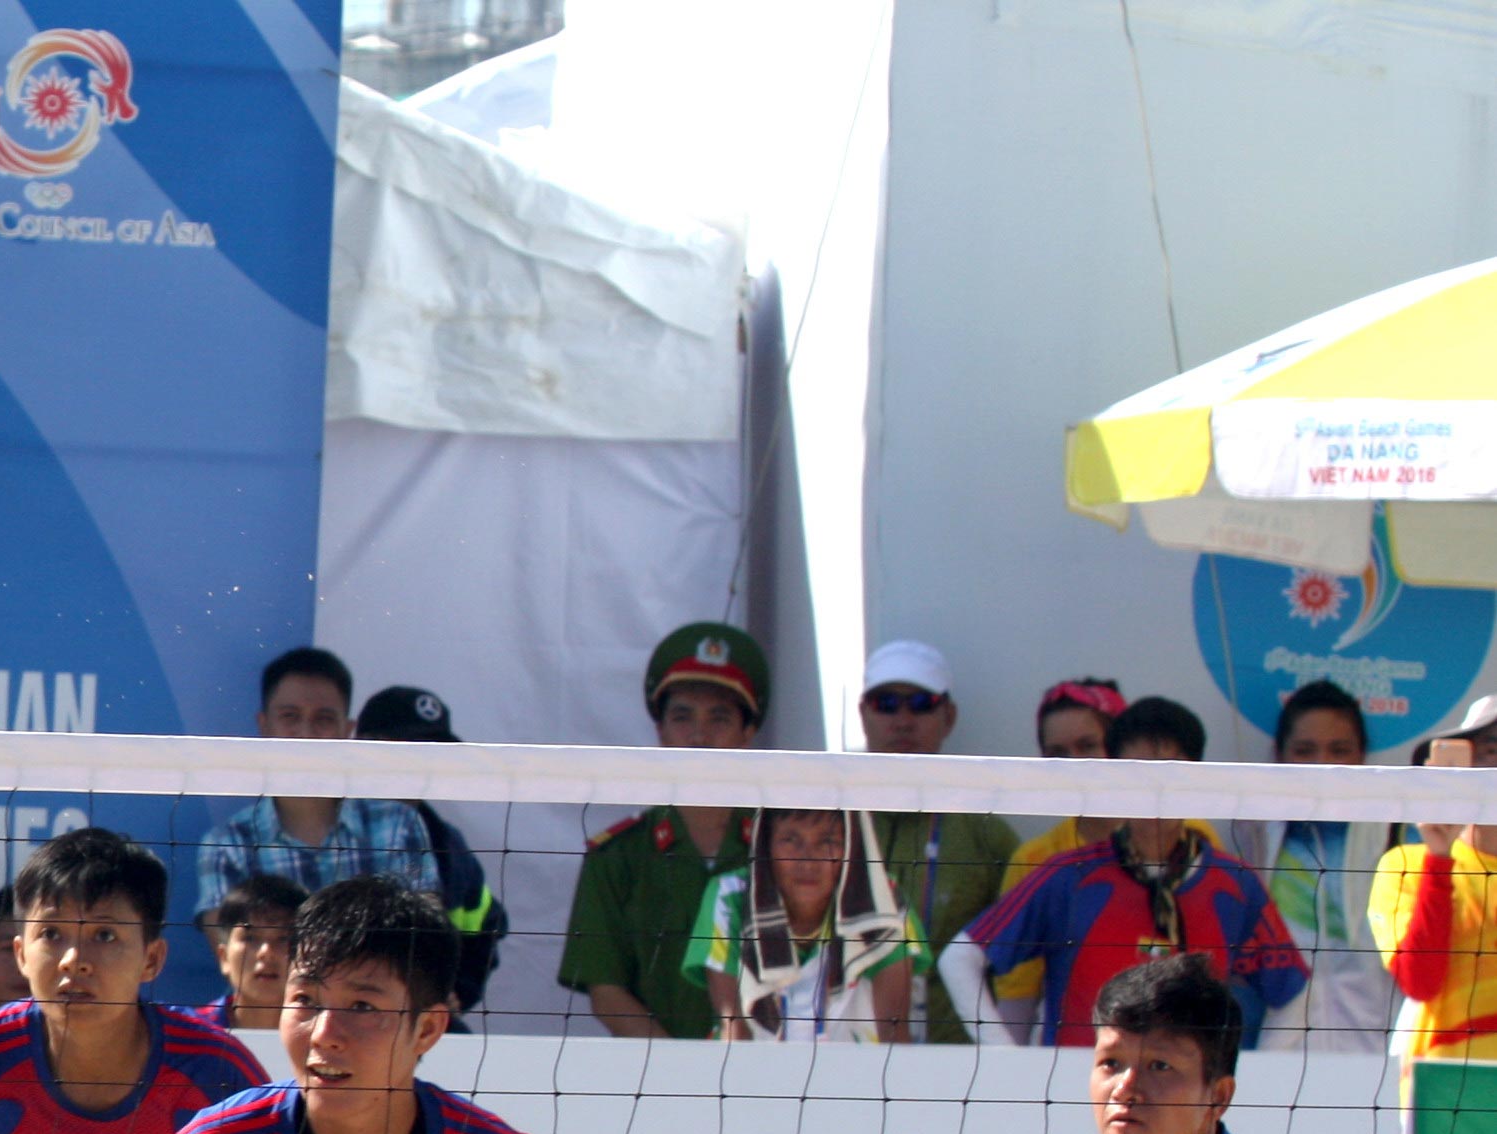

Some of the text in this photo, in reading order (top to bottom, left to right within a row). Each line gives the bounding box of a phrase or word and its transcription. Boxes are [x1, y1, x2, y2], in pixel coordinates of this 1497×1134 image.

[1327, 442, 1419, 462] DA NANG
[1308, 466, 1437, 484] VIET NAM 2016
